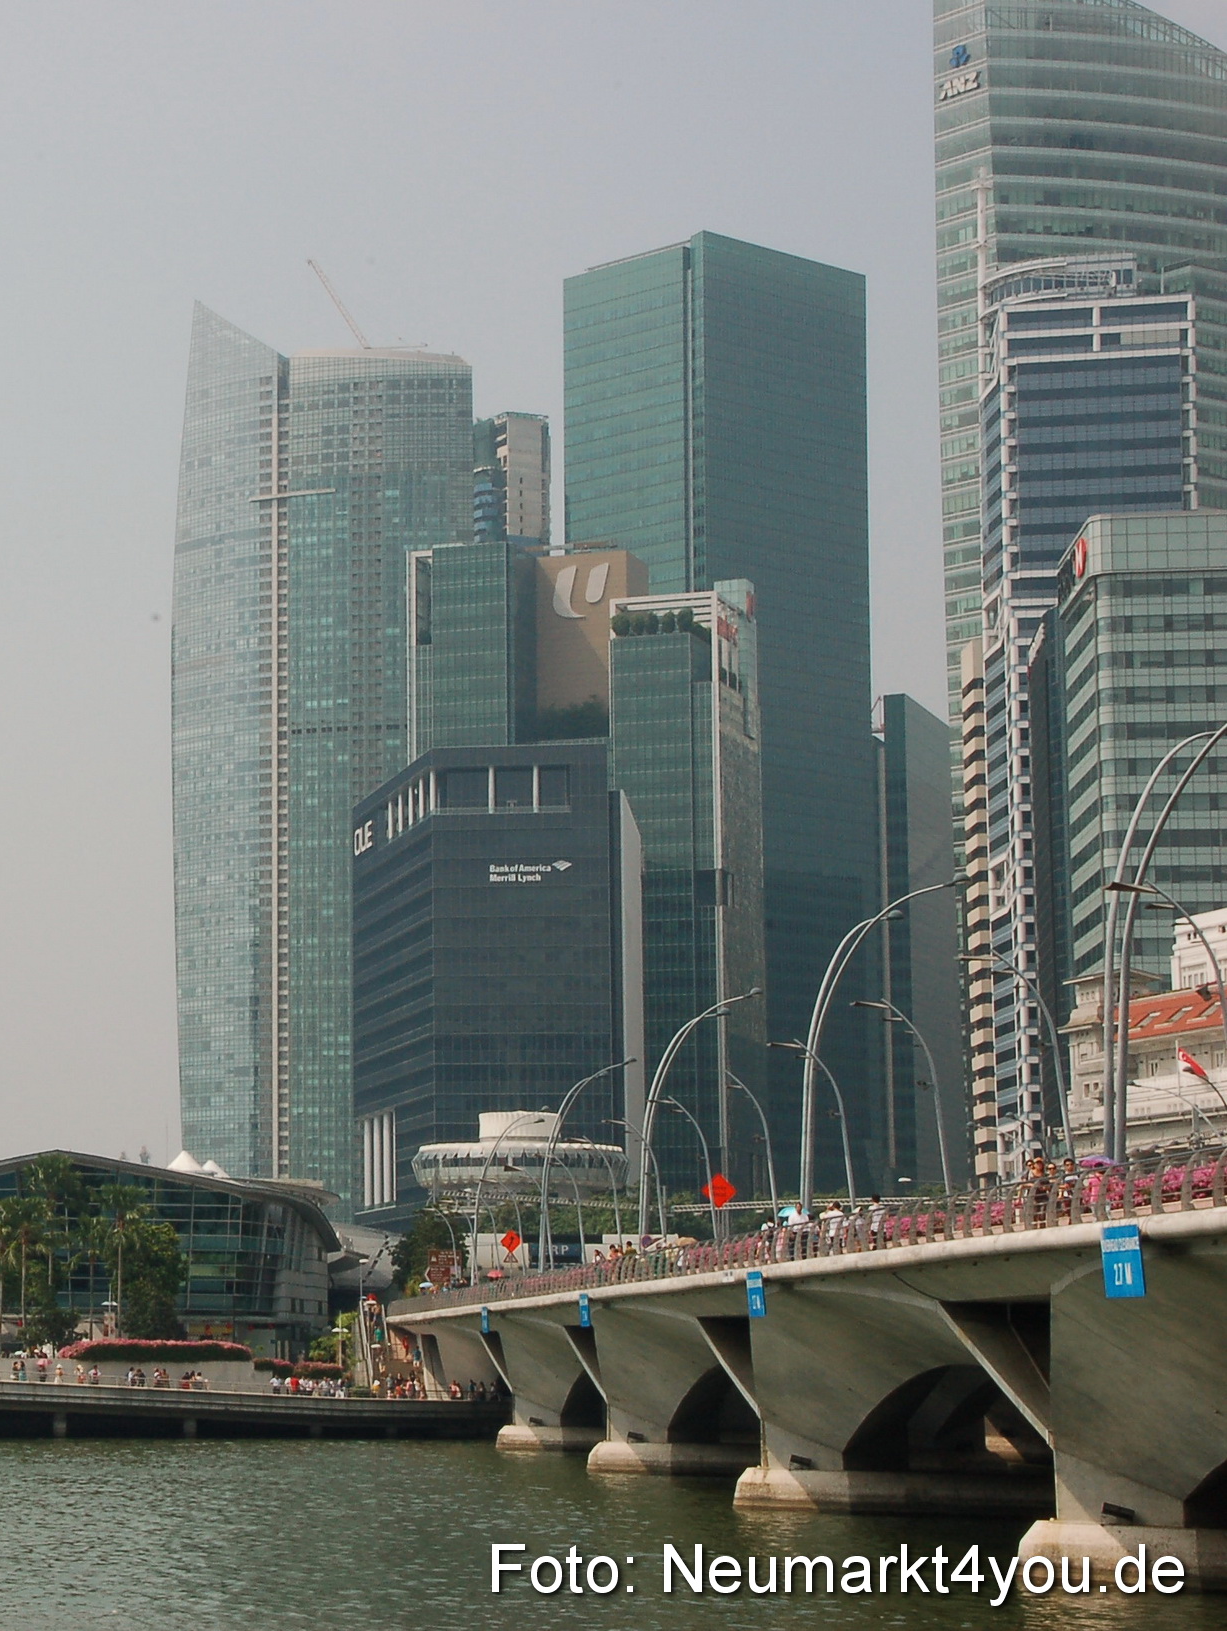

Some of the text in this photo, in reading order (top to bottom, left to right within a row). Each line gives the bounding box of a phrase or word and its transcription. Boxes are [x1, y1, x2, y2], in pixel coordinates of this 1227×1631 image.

[939, 71, 980, 101] ANZ
[489, 864, 552, 873] Bank of America
[489, 873, 542, 883] Merrill Lynch
